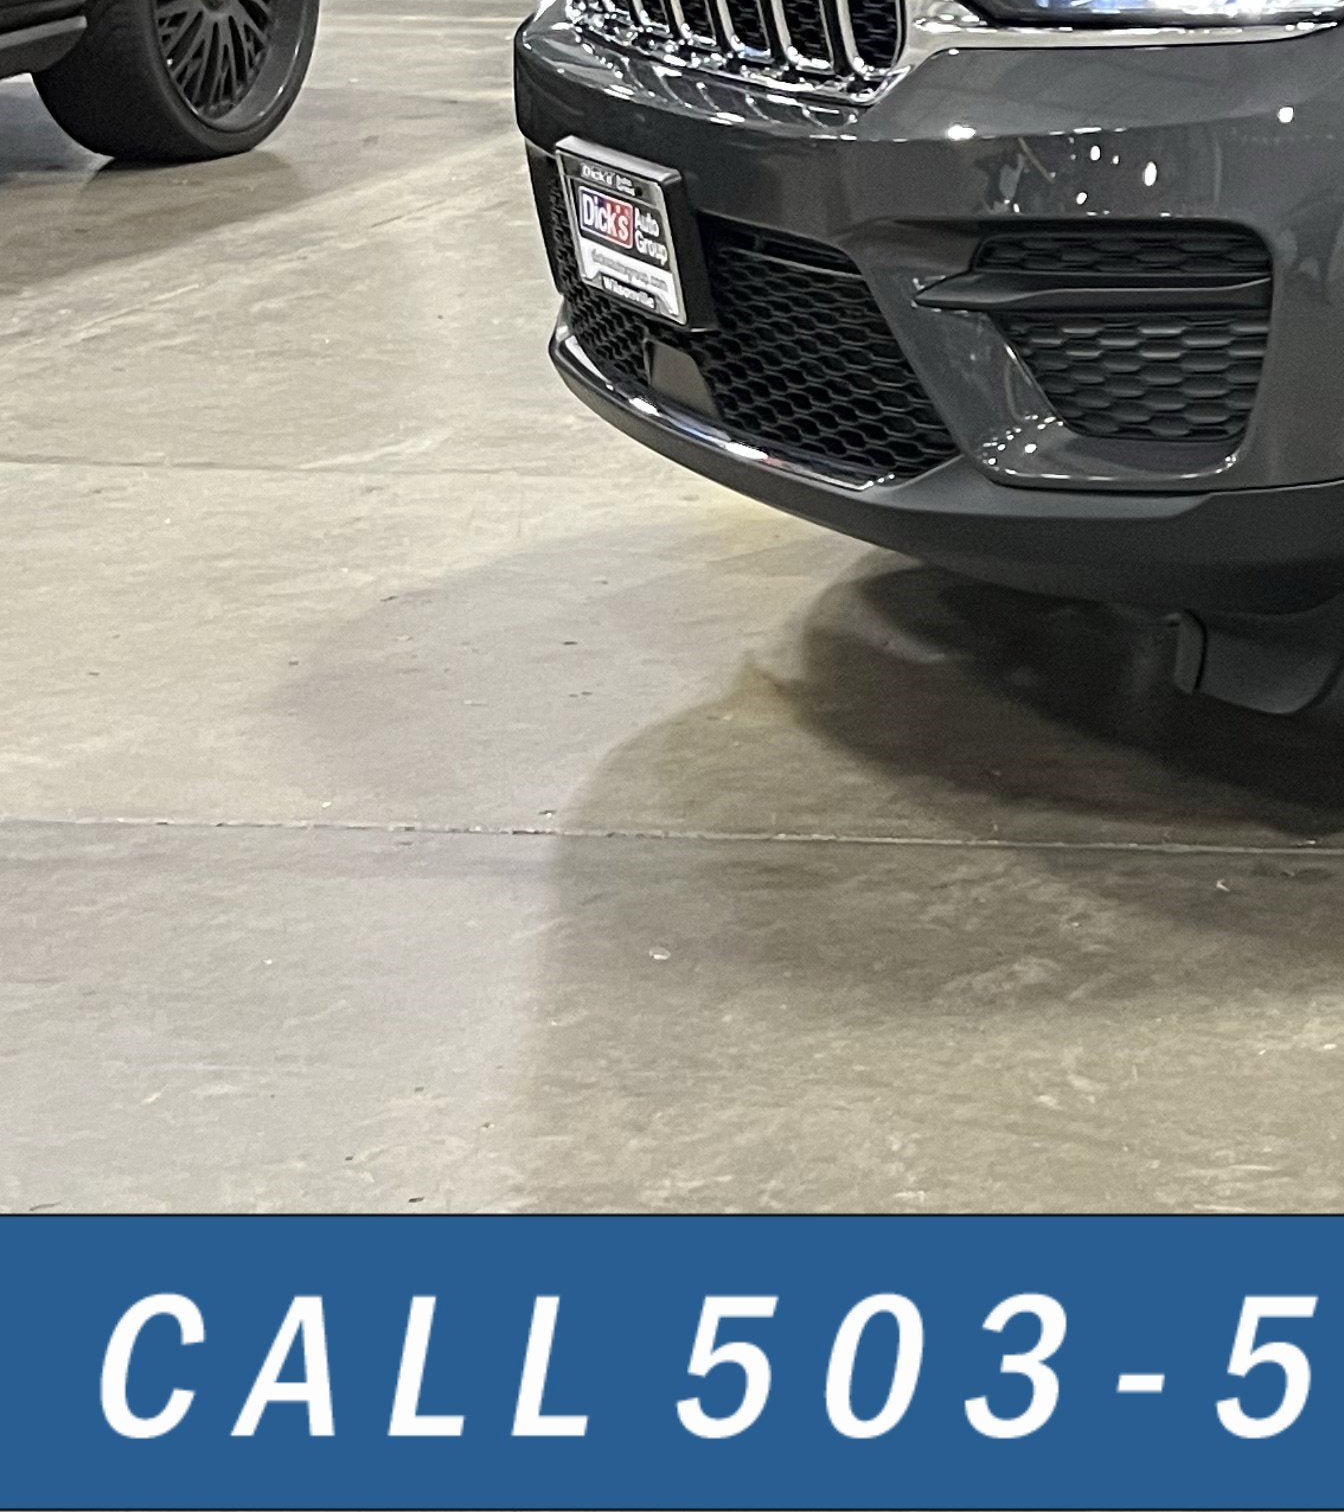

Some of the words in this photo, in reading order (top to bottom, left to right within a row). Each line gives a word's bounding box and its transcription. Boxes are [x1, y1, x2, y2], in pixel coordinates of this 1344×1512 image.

[582, 192, 630, 243] Dick's
[634, 206, 660, 238] Auto
[634, 229, 668, 266] Group
